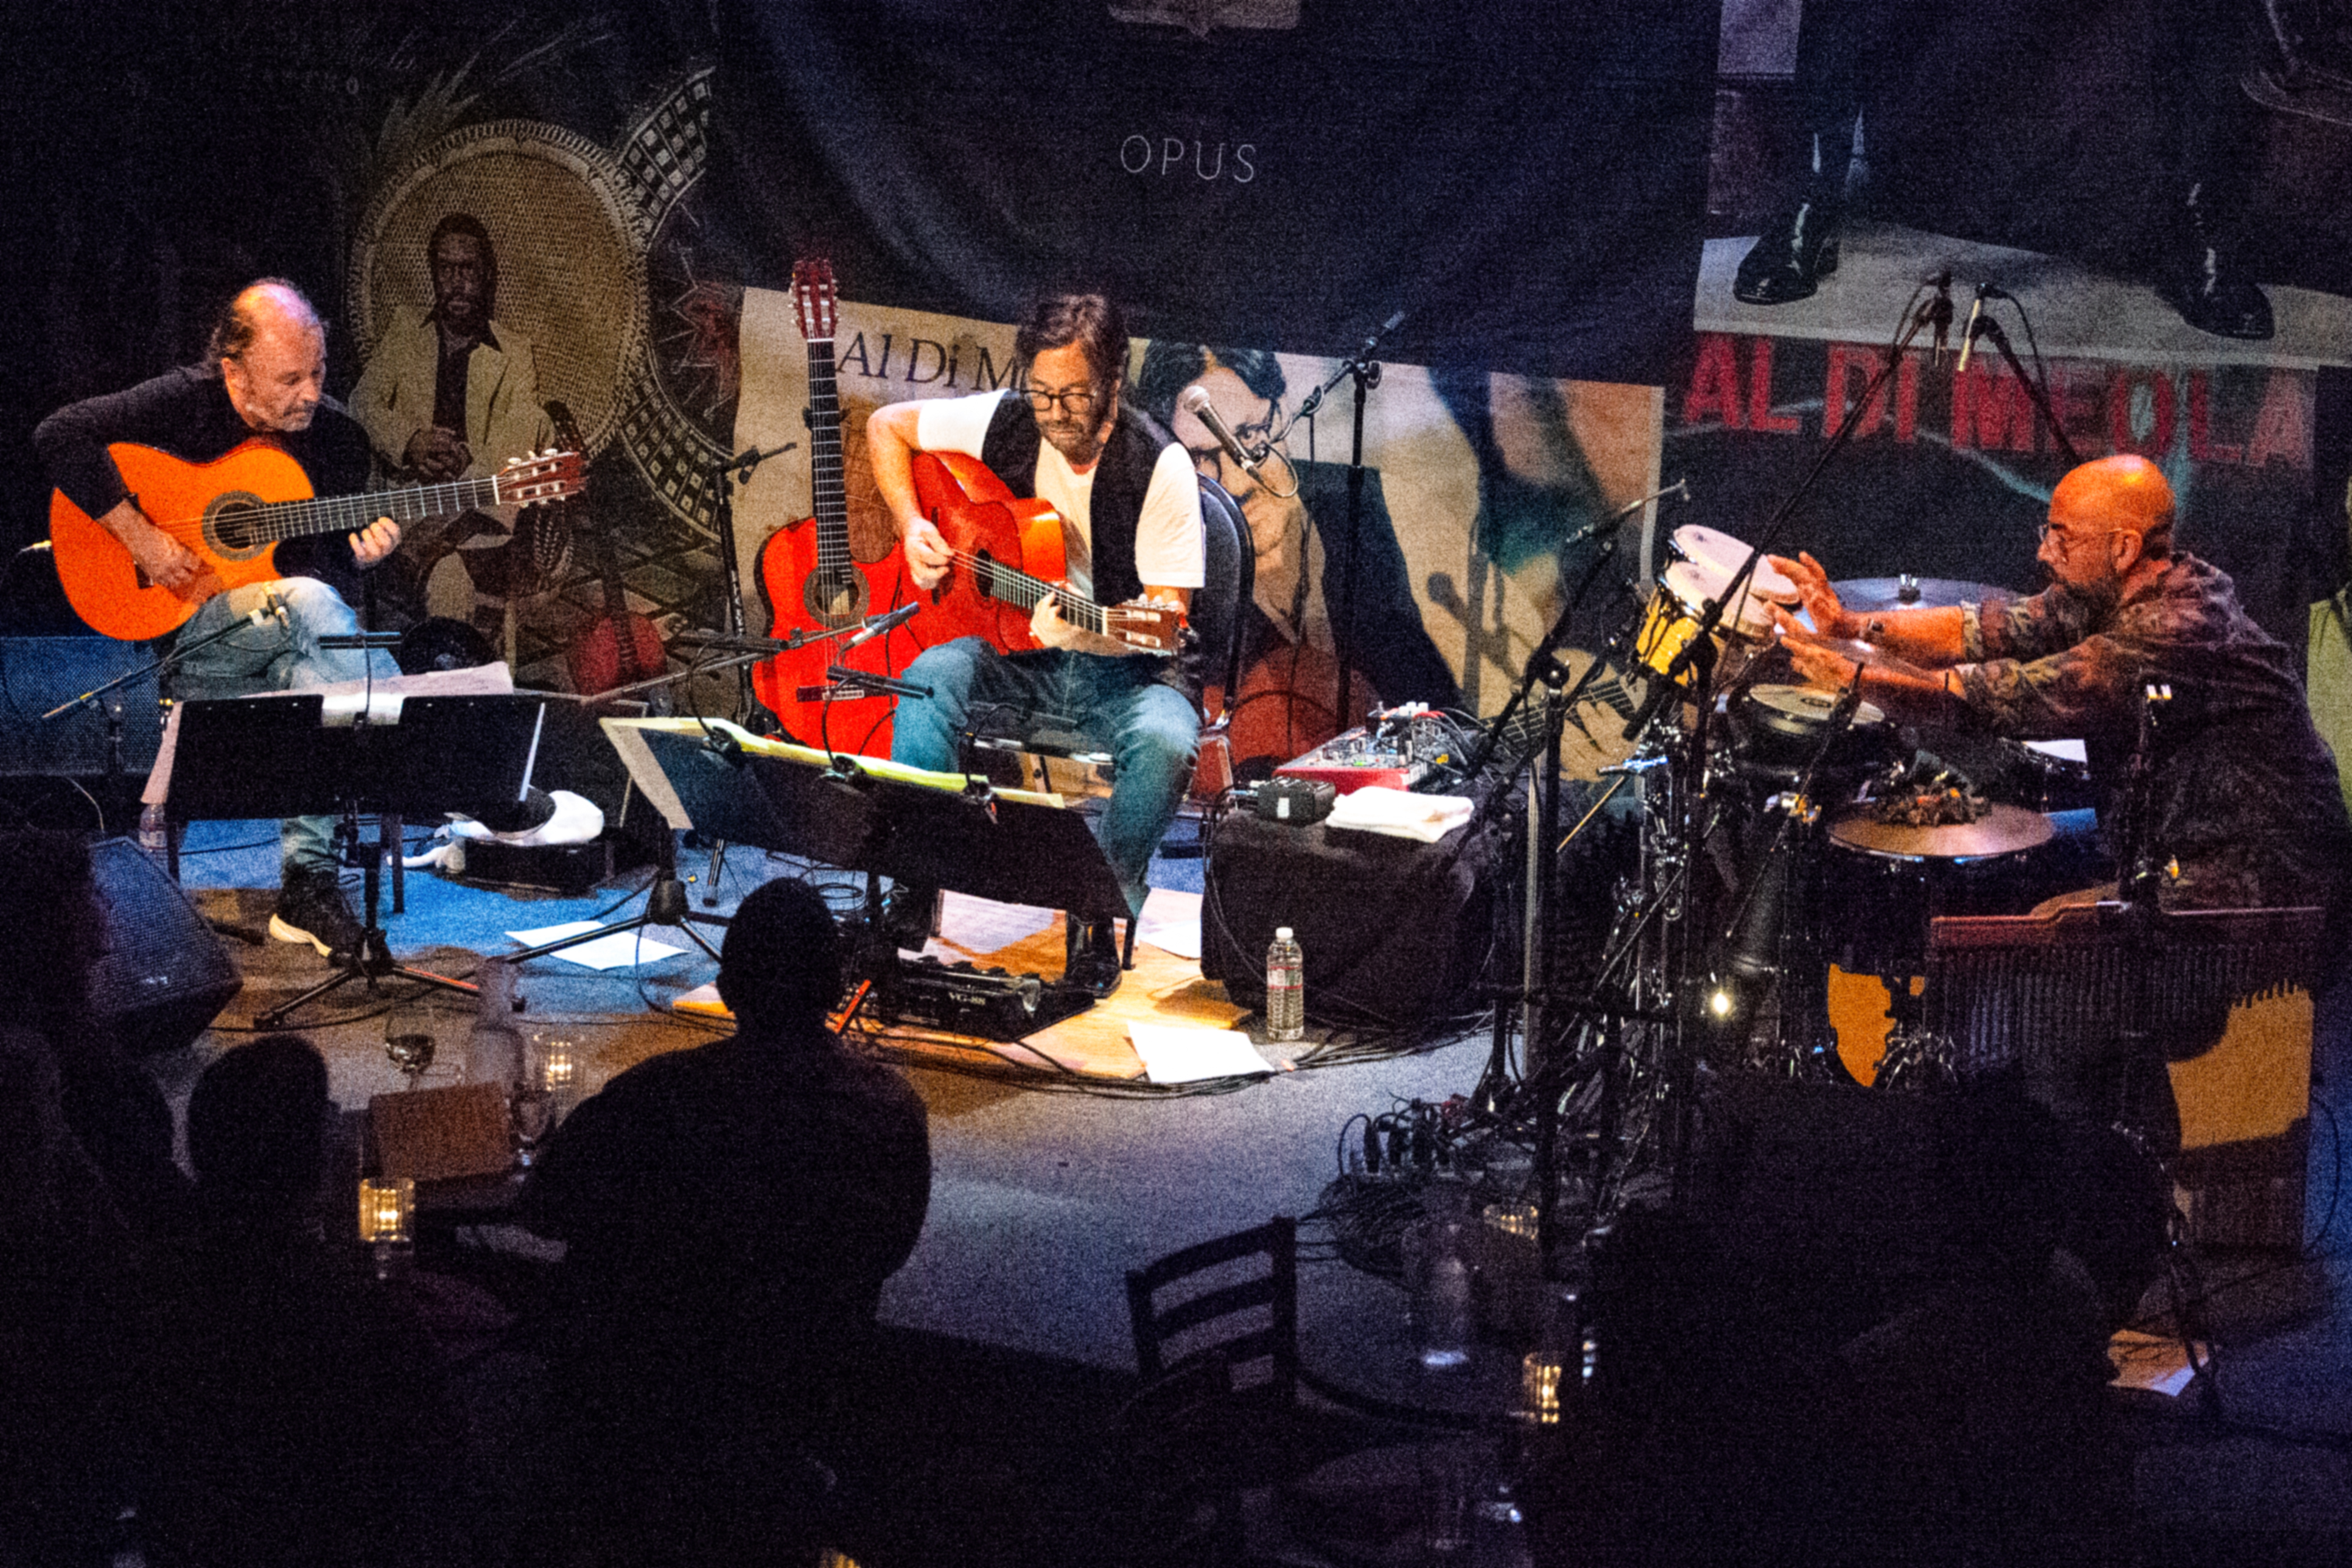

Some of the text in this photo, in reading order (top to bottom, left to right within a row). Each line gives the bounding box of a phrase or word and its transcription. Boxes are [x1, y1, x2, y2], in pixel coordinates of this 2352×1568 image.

[1119, 133, 1257, 183] OPUS
[905, 337, 961, 388] Di
[970, 345, 1029, 393] M
[1682, 331, 1800, 434] AL
